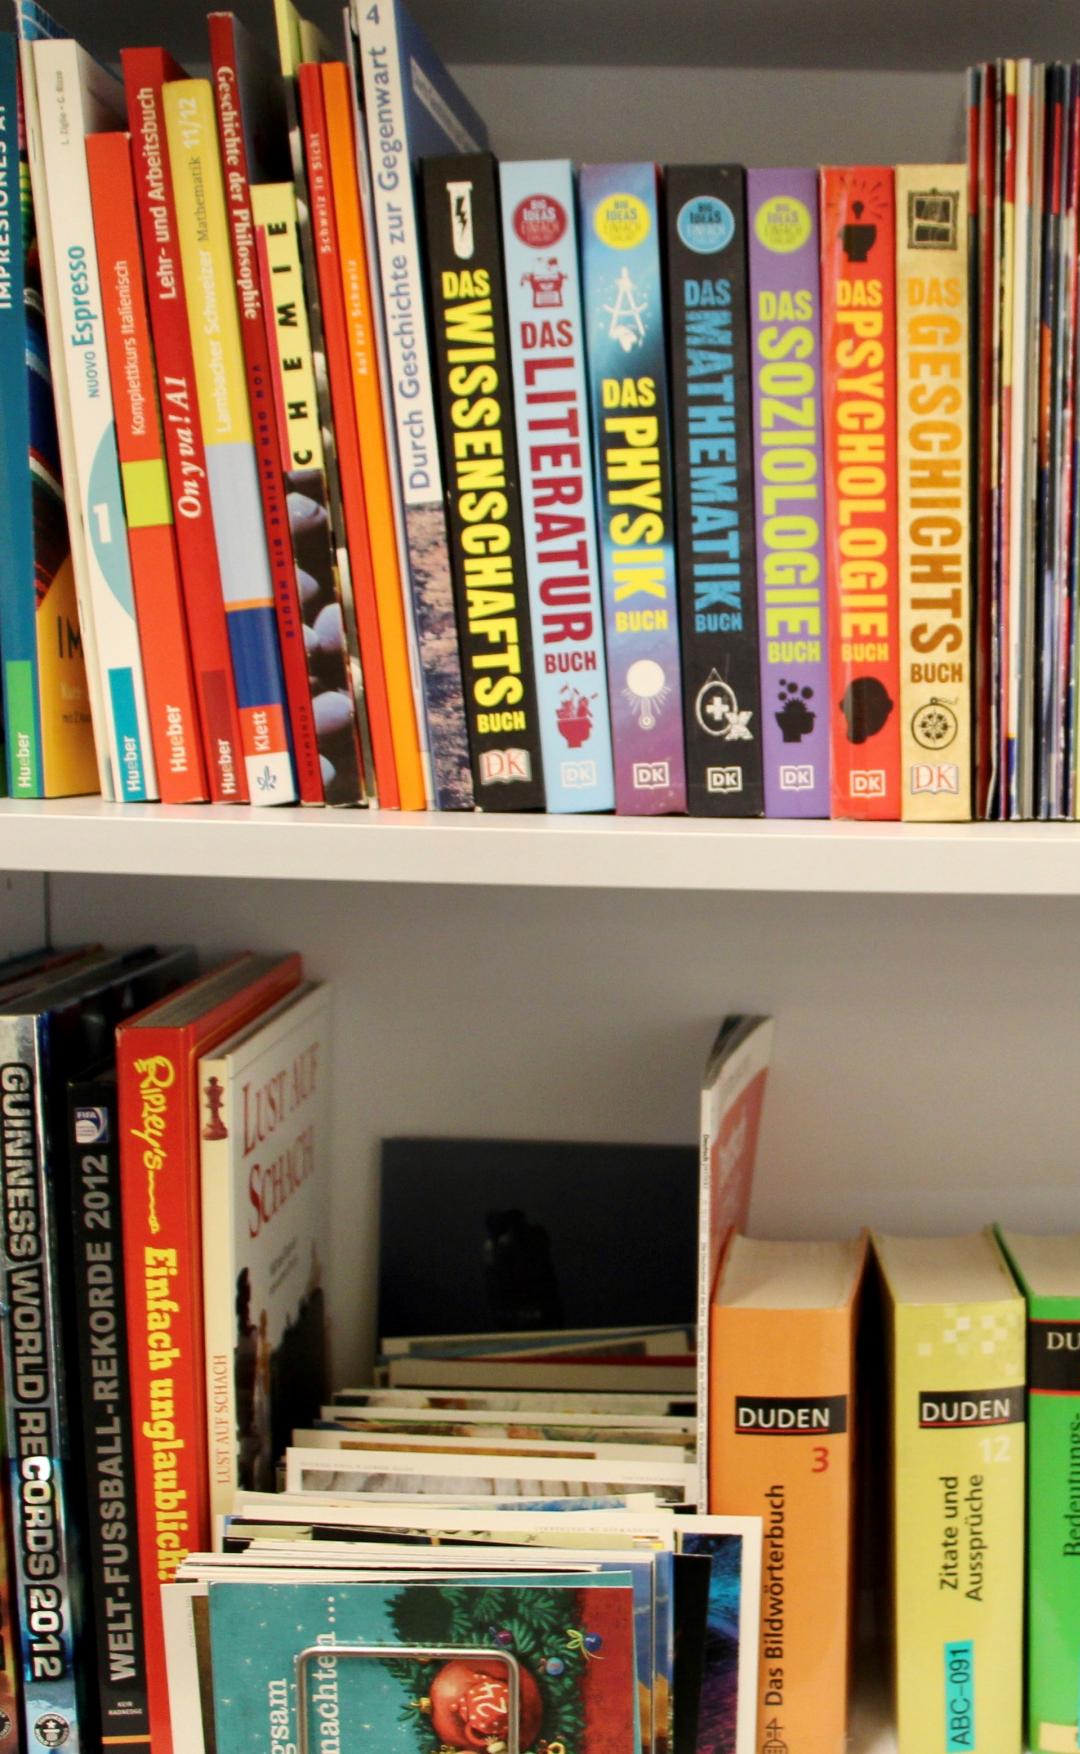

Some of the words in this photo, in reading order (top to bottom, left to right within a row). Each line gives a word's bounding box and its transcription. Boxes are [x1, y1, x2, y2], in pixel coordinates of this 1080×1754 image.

[178, 98, 201, 150] 11/12
[216, 66, 240, 166] Geschichte
[373, 47, 403, 190] Gegenwart
[136, 88, 162, 200] Arbeitsbuch
[188, 156, 209, 242] Mathematik
[225, 172, 244, 204] der
[150, 207, 168, 241] und
[317, 195, 331, 253] Schweiz
[382, 202, 402, 246] zur
[155, 249, 176, 299] Lehr-
[233, 208, 259, 320] Philosophie
[442, 269, 490, 299] DAS
[67, 245, 97, 347] Espresso
[115, 260, 134, 336] Italienisch
[199, 250, 221, 335] Schweizer
[684, 280, 731, 306] DAS
[759, 291, 813, 321] DAS
[836, 280, 882, 306] DAS
[908, 279, 962, 305] DAS
[389, 256, 421, 398] Geschichte
[521, 320, 573, 349] DAS
[86, 351, 100, 398] NUOVO
[123, 337, 146, 435] Komplettkurs
[209, 339, 231, 433] Lambacher
[602, 378, 656, 408] DAS
[402, 410, 431, 488] Durch
[685, 310, 742, 613] MATHEMATIK
[178, 482, 201, 518] On
[523, 357, 595, 645] LITERATUR
[759, 326, 820, 636] SOZIOLOGIE
[837, 312, 888, 639] PSYCHOLOGIE
[908, 316, 963, 653] GESCHICHTS
[92, 504, 113, 544] 1
[445, 298, 524, 708] WISSENSCHAFTS
[605, 417, 667, 601] PHYSIK
[615, 612, 668, 633] BUCH
[695, 614, 743, 633] BUCH
[545, 652, 597, 673] BUCH
[768, 641, 821, 663] BUCH
[841, 643, 889, 663] BUCH
[910, 664, 963, 683] BUCH
[167, 705, 187, 772] Hueber
[256, 711, 269, 752] Klett
[477, 711, 526, 734] BUCH
[17, 732, 32, 789] Hueber
[125, 736, 143, 792] Hueber
[215, 739, 235, 794] Hueber
[484, 755, 523, 781] DK
[637, 768, 663, 785] DK
[711, 772, 738, 788] DK
[784, 770, 811, 786] DK
[854, 776, 881, 793] DK
[913, 766, 955, 789] DK
[76, 1111, 98, 1120] FIFA
[242, 1070, 286, 1157] LUST
[1, 1066, 38, 1259] GUINNESS
[82, 1155, 111, 1229] 2012
[11, 1267, 51, 1402] WORLD
[144, 1247, 181, 1371] Einfach
[213, 1355, 229, 1417] SCHACH
[922, 1399, 1010, 1422] DUDEN
[215, 1419, 230, 1450] AUF
[738, 1407, 829, 1428] DUDEN
[216, 1452, 230, 1485] LUST
[811, 1446, 829, 1472] 3
[980, 1436, 1010, 1463] 12
[18, 1411, 54, 1577] RECORDS
[940, 1476, 959, 1520] und
[940, 1526, 959, 1590] Zitate
[965, 1474, 984, 1602] Aussprüche
[764, 1485, 785, 1658] Bildwörterbuch
[30, 1588, 62, 1680] 2012
[764, 1668, 785, 1706] Das
[947, 1648, 971, 1746] ABC-091
